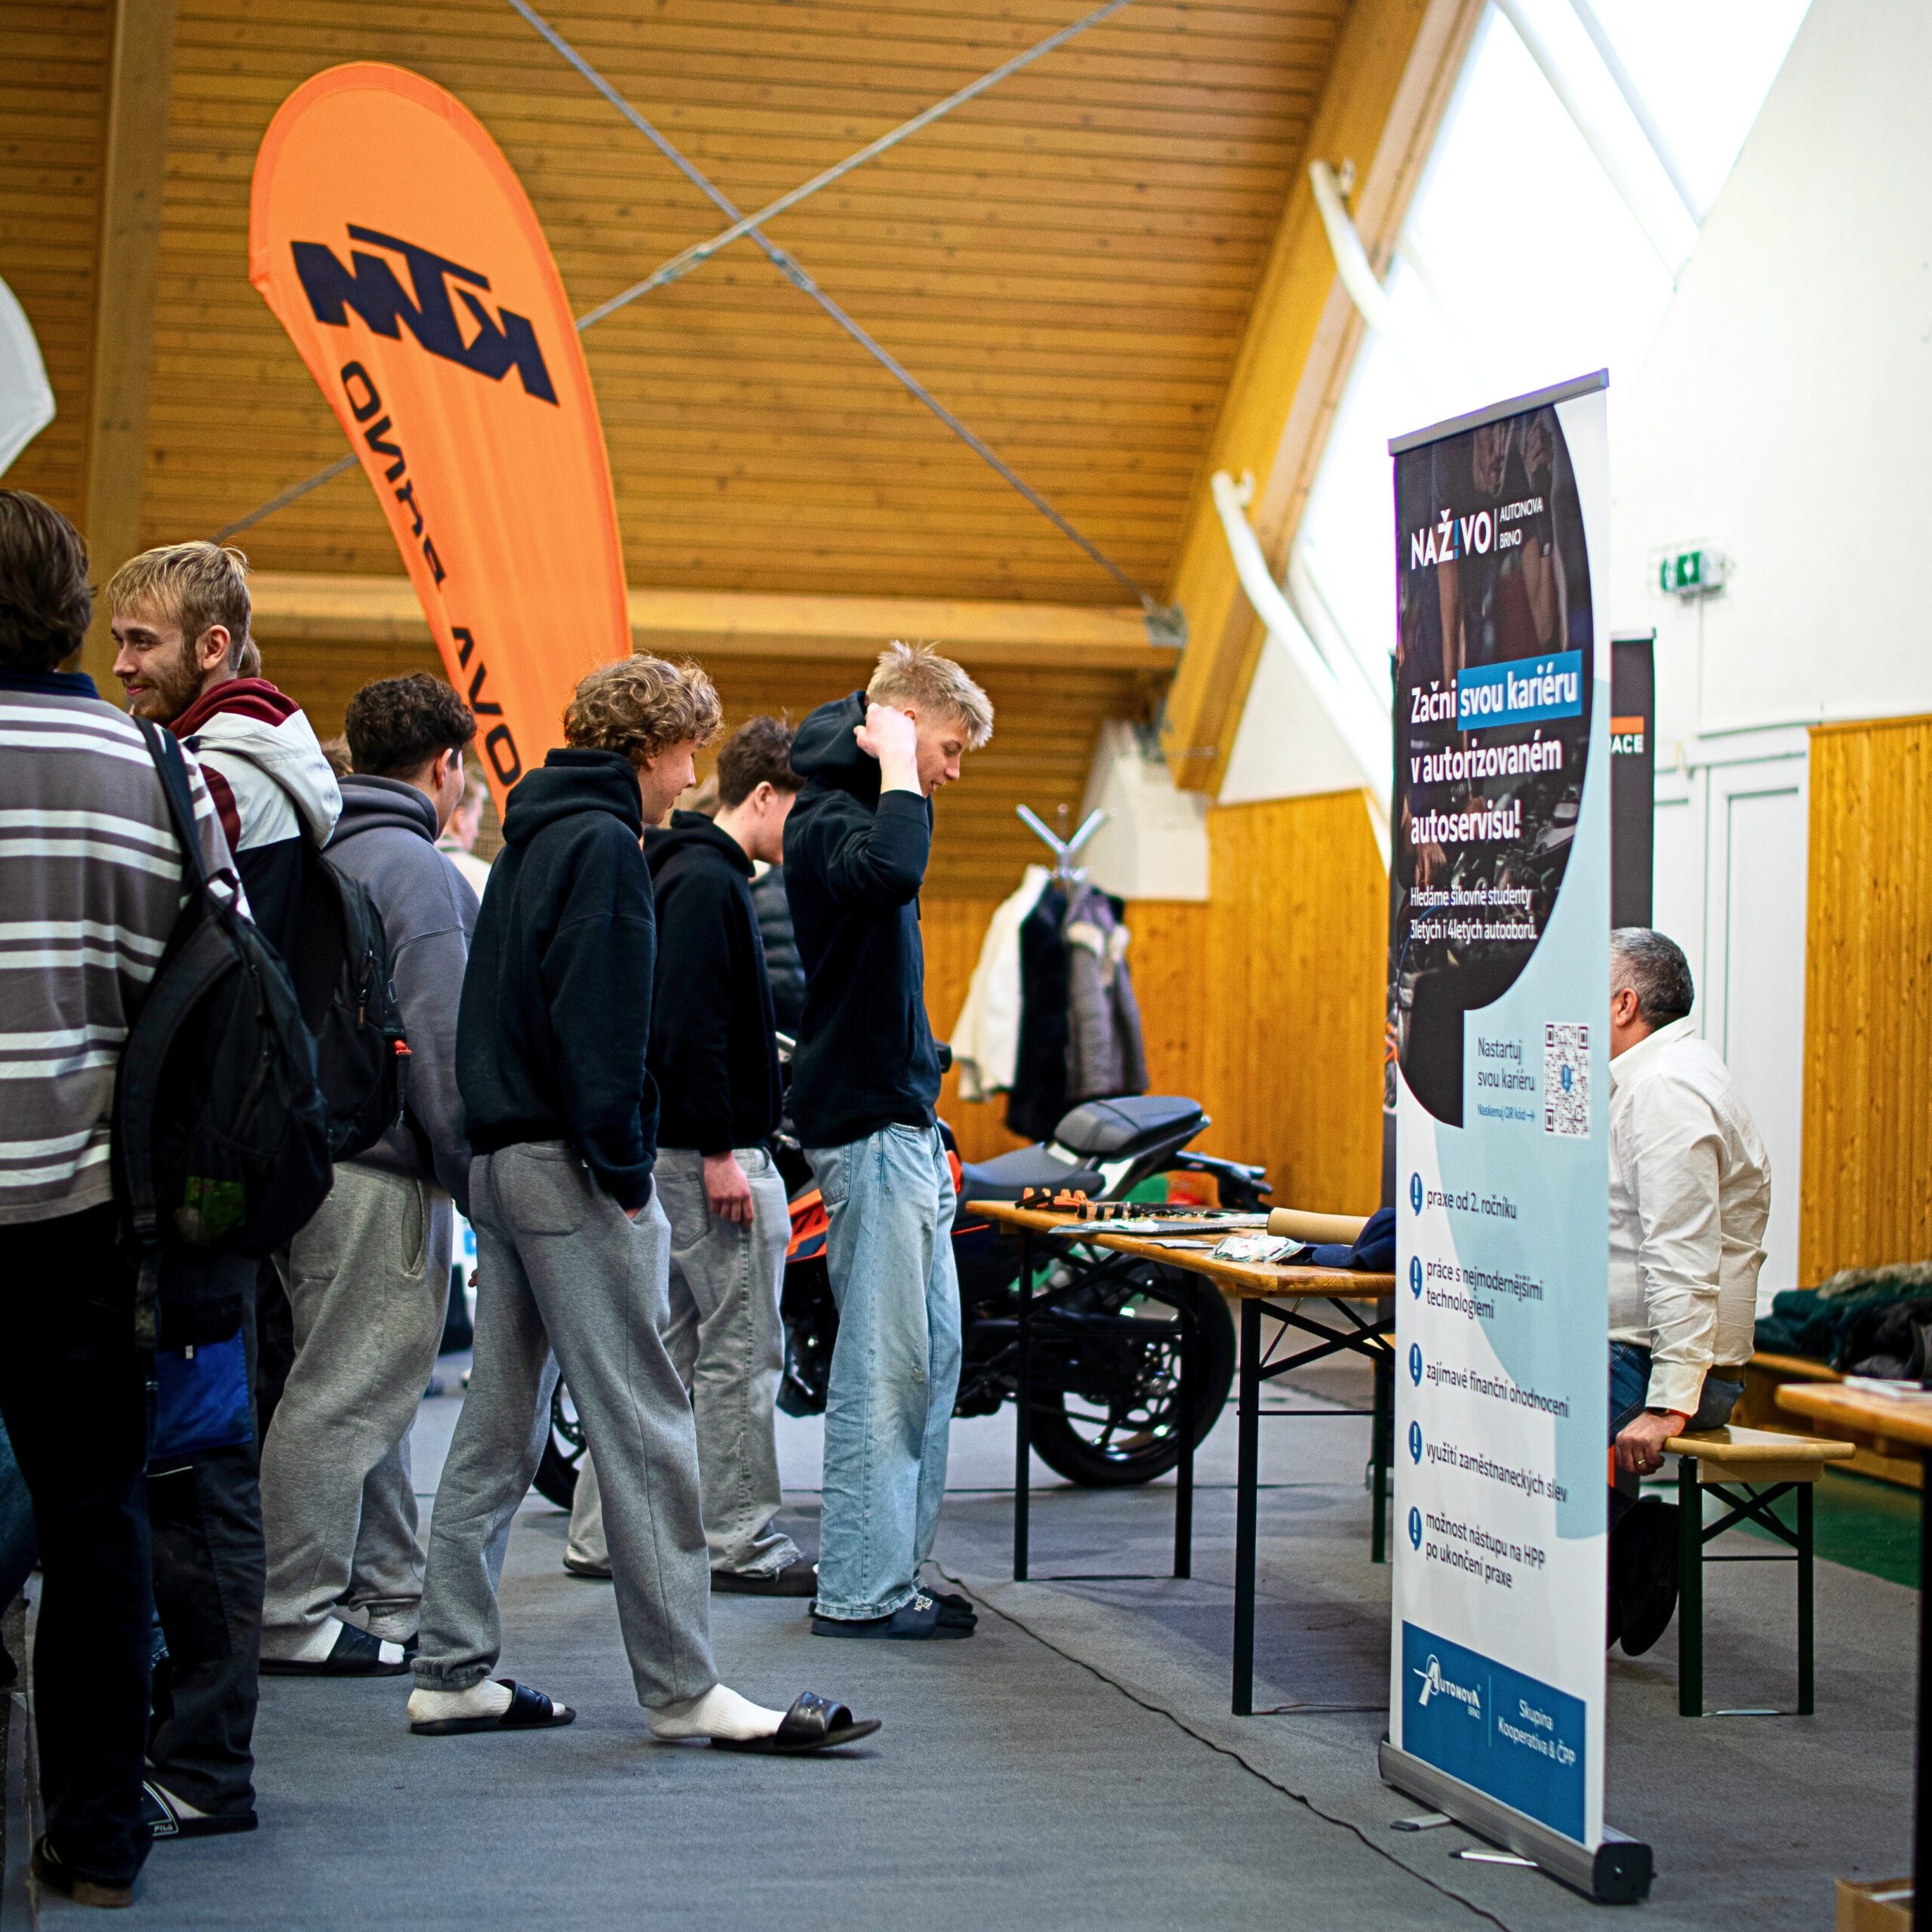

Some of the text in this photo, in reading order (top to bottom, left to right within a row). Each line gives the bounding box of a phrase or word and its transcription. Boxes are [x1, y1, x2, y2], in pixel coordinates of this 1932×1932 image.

[1500, 497, 1543, 523] AUTONOVA
[1500, 528, 1522, 549] BRNO
[1411, 661, 1578, 724] Začni svou kariéru
[1411, 729, 1562, 783] v autorizovaném
[1610, 734, 1644, 753] ACE
[1411, 798, 1521, 844] autoservisu!
[1410, 884, 1532, 909] Hledáme šikovné studenty
[1410, 919, 1441, 944] 3letých
[1442, 920, 1447, 939] i
[1447, 918, 1482, 944] 4letých
[1477, 1036, 1522, 1065] Nastartuj
[1477, 1065, 1535, 1091] svou kariéru
[1477, 1103, 1503, 1121] Naskenuj
[1505, 1106, 1513, 1118] QR
[1426, 1190, 1517, 1220] praxe od 2. ročníku
[1426, 1257, 1543, 1301] práce s nejmodernějšími
[1426, 1287, 1495, 1319] technologiemi
[1426, 1361, 1570, 1418] zajímavé finanční ohodnocení
[1426, 1441, 1567, 1503] využití zaměstnaneckých slev
[1426, 1511, 1545, 1570] možnost nástupu na HPP
[1426, 1540, 1513, 1589] po ukončení praxe
[1519, 1698, 1553, 1731] Skupina
[1498, 1715, 1548, 1756] Kooperativa
[1549, 1740, 1556, 1760] &
[154, 1823, 173, 1833] FILA
